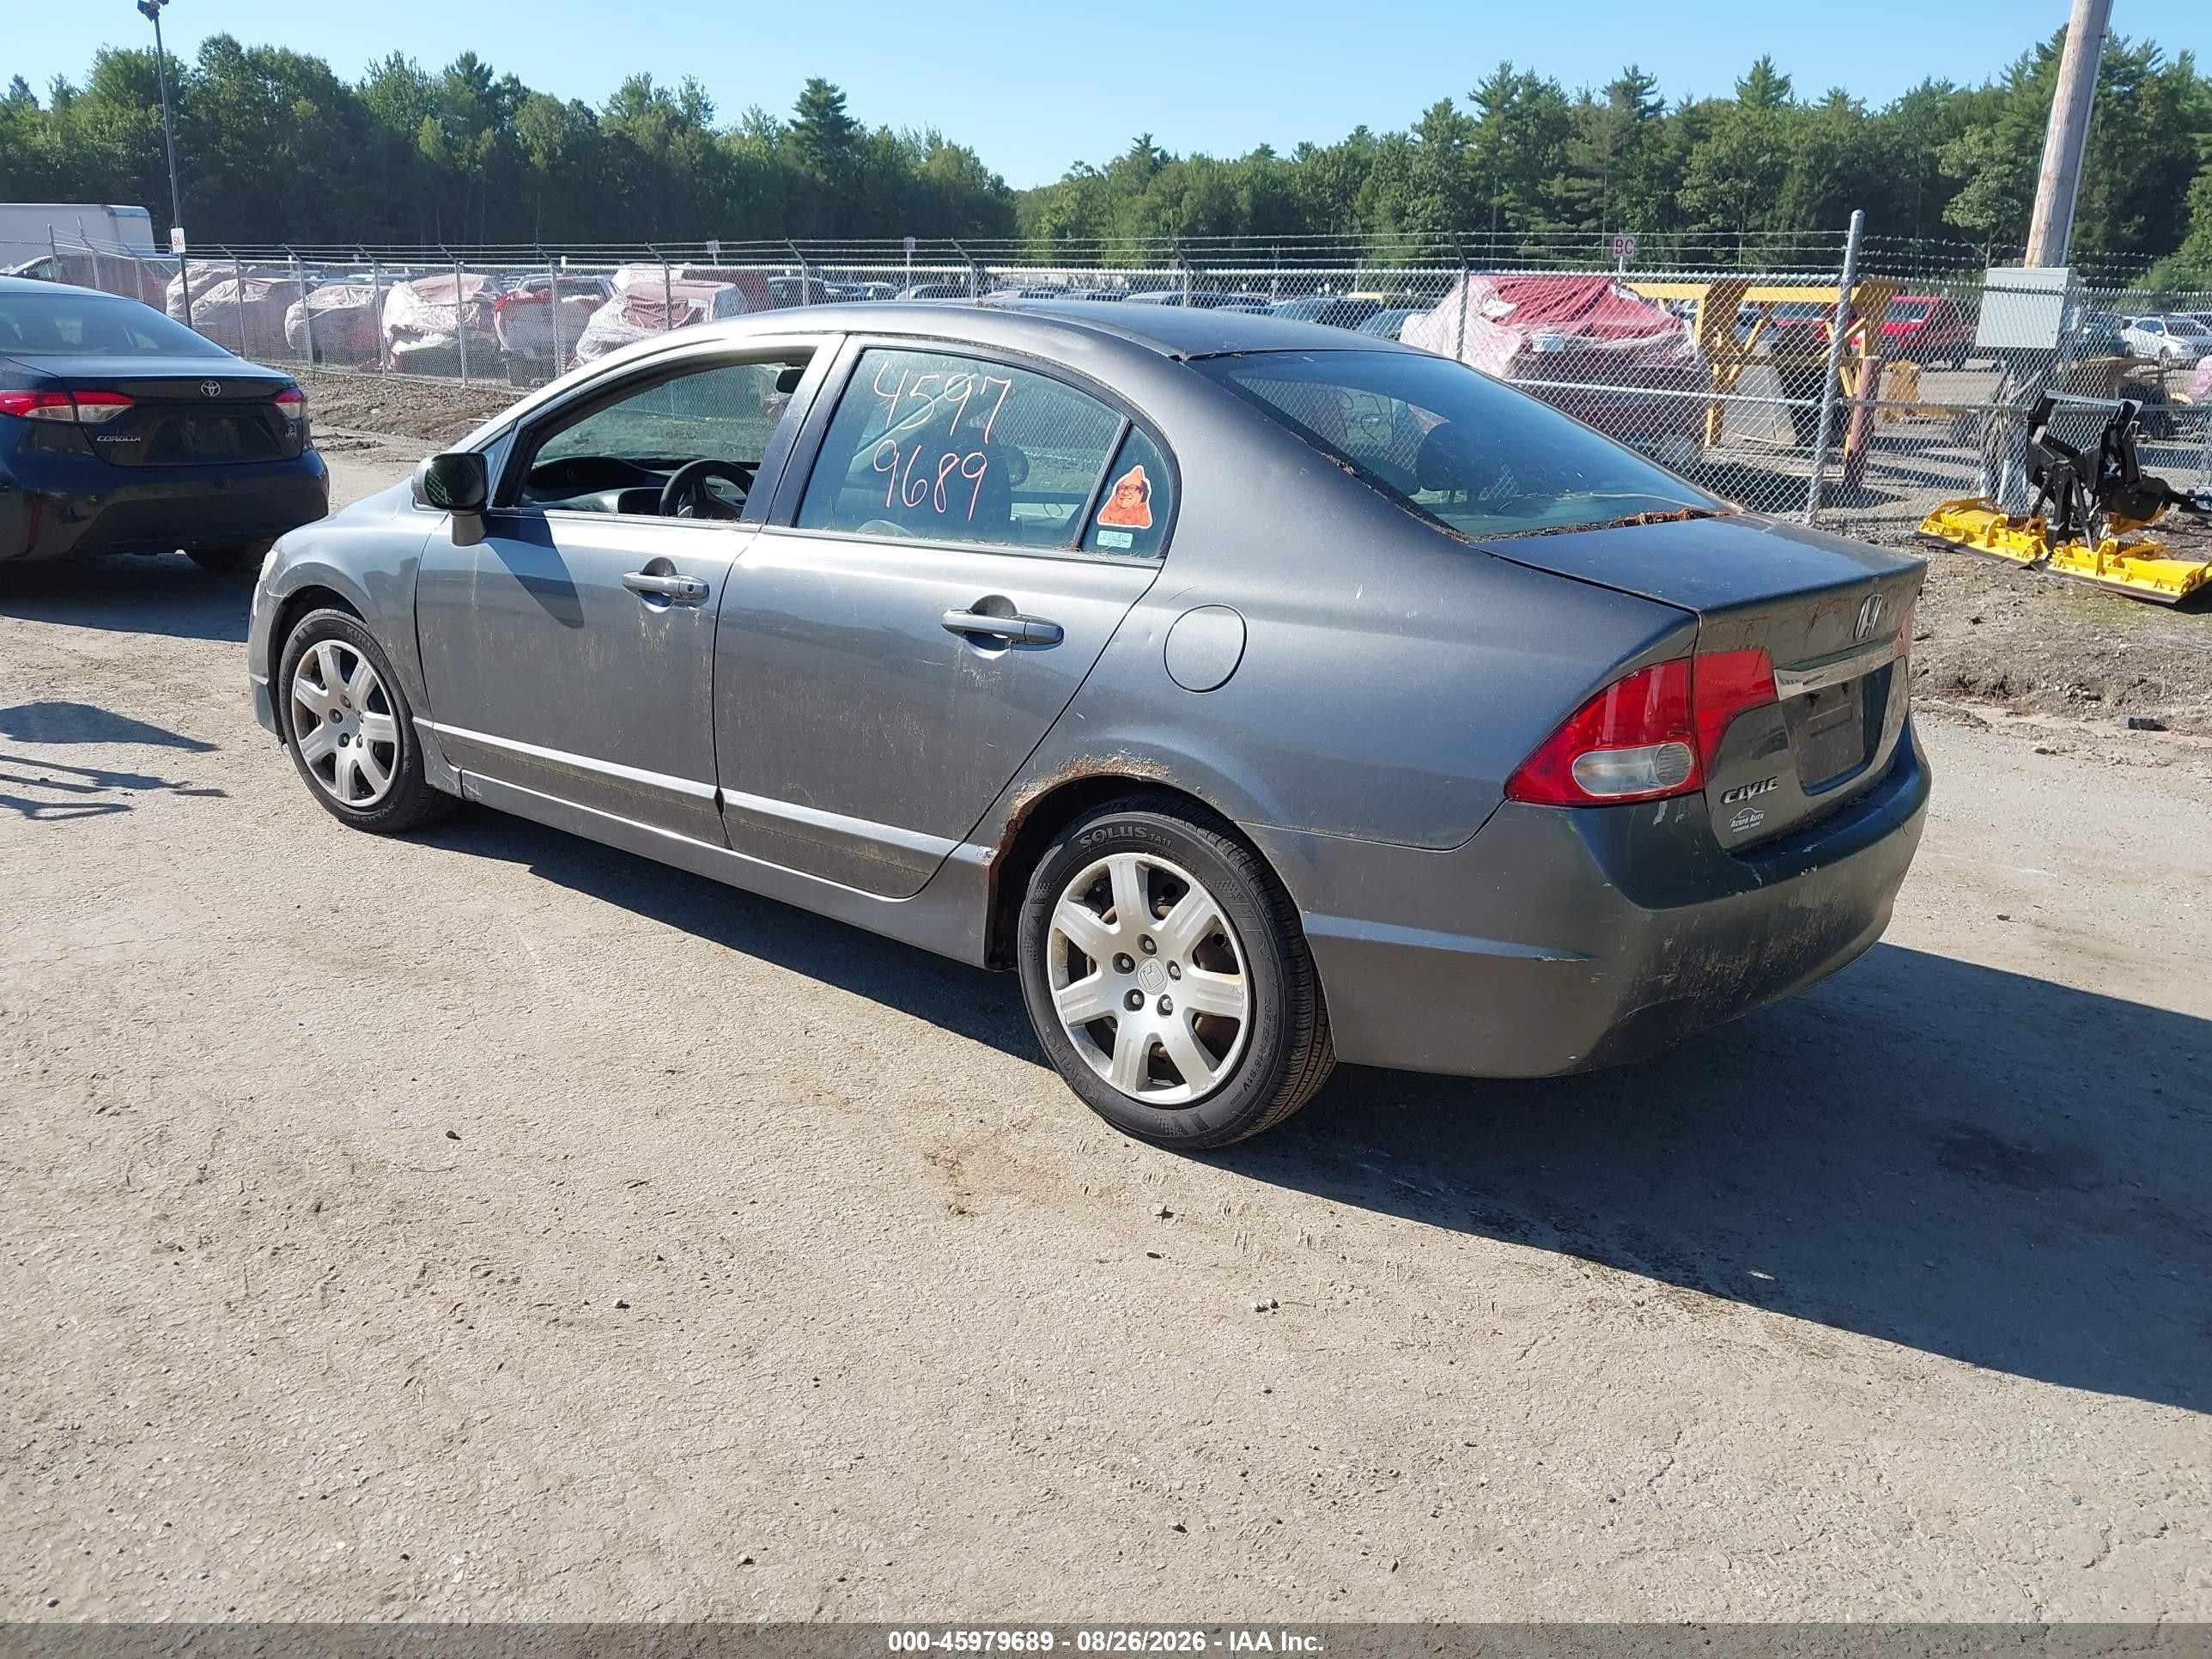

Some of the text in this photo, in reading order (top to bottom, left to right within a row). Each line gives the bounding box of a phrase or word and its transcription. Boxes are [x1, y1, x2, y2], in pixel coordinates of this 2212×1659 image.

[1615, 240, 1634, 255] BC
[874, 361, 1012, 444] 4597
[873, 439, 988, 520] 9689
[1721, 776, 1778, 804] CIVIC
[1079, 825, 1148, 848] SOLUS
